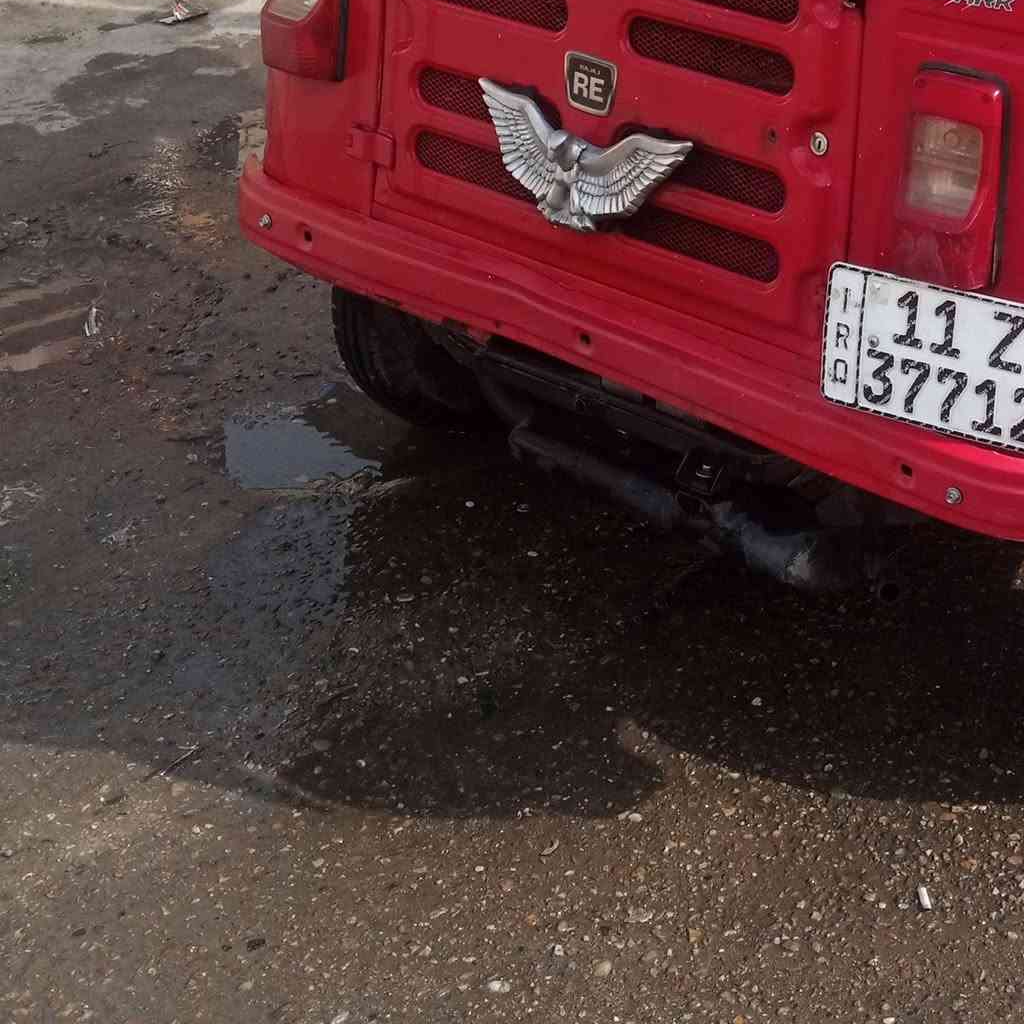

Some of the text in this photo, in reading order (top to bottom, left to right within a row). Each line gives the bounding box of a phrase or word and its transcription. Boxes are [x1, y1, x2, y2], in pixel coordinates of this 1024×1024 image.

[573, 71, 605, 104] RE
[830, 286, 852, 386] IRQ
[893, 290, 961, 360] 11
